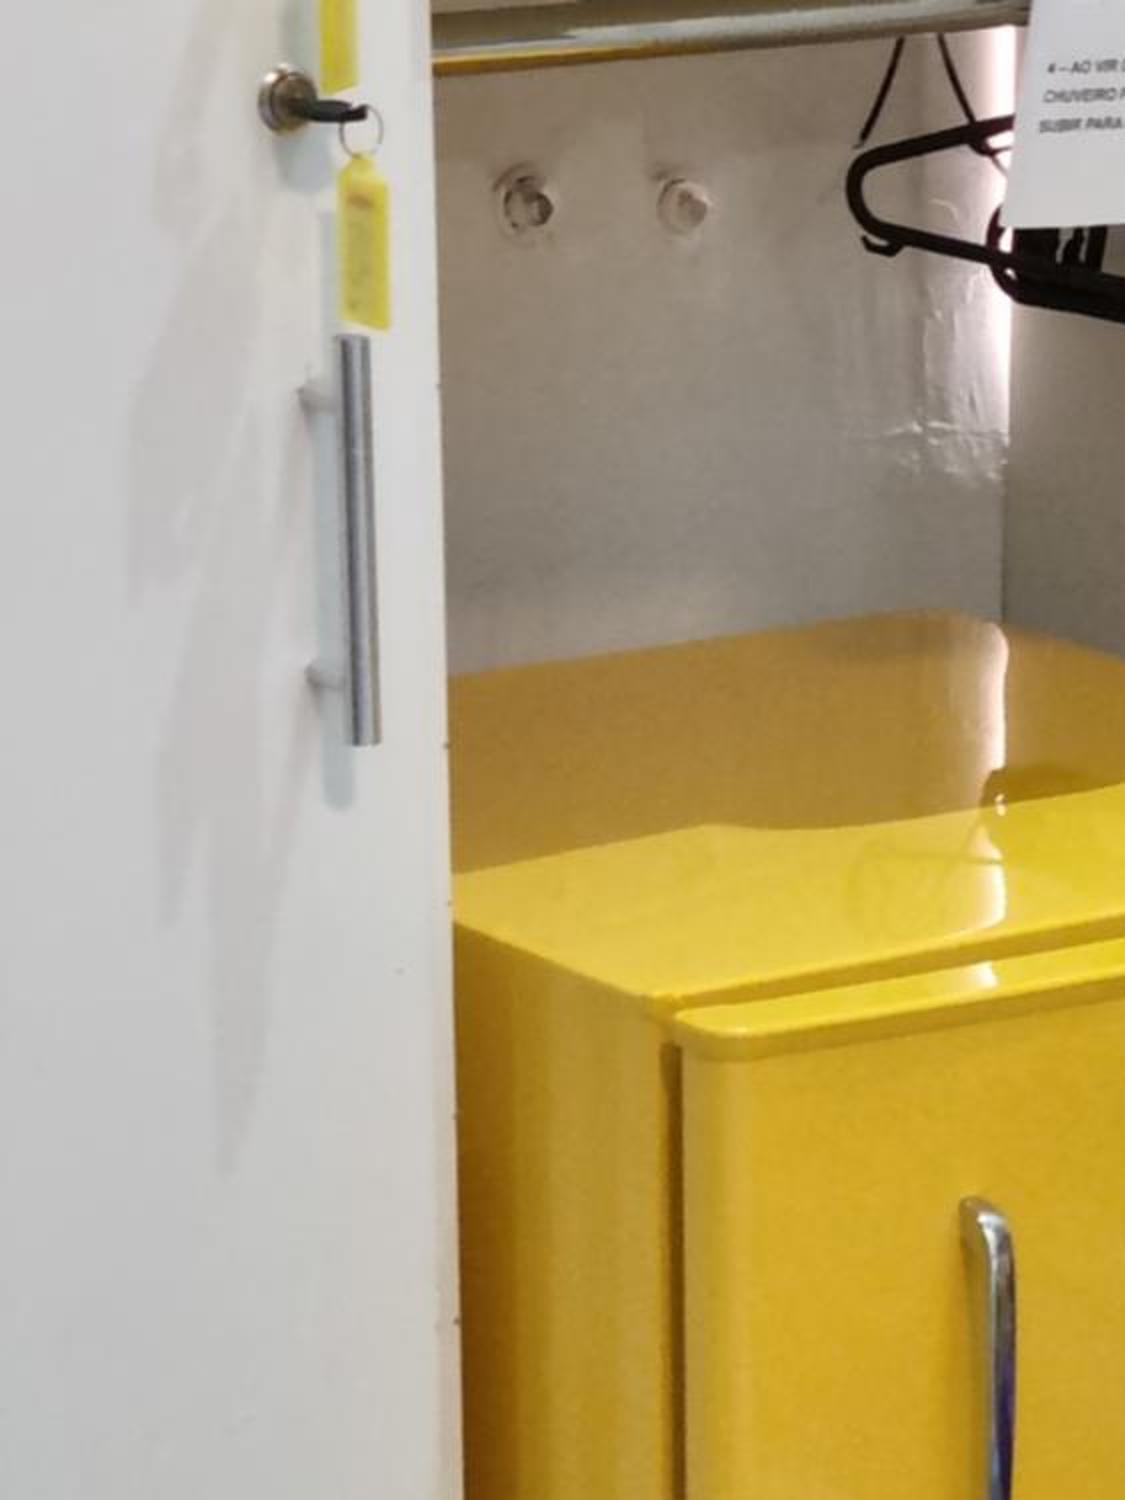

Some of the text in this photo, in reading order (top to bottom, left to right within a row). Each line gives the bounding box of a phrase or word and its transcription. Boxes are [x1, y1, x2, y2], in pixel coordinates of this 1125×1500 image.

[1071, 59, 1091, 74] AO
[1043, 87, 1118, 104] CHUVEIRO
[1038, 117, 1083, 134] SUBIR
[1084, 115, 1123, 130] PARA
